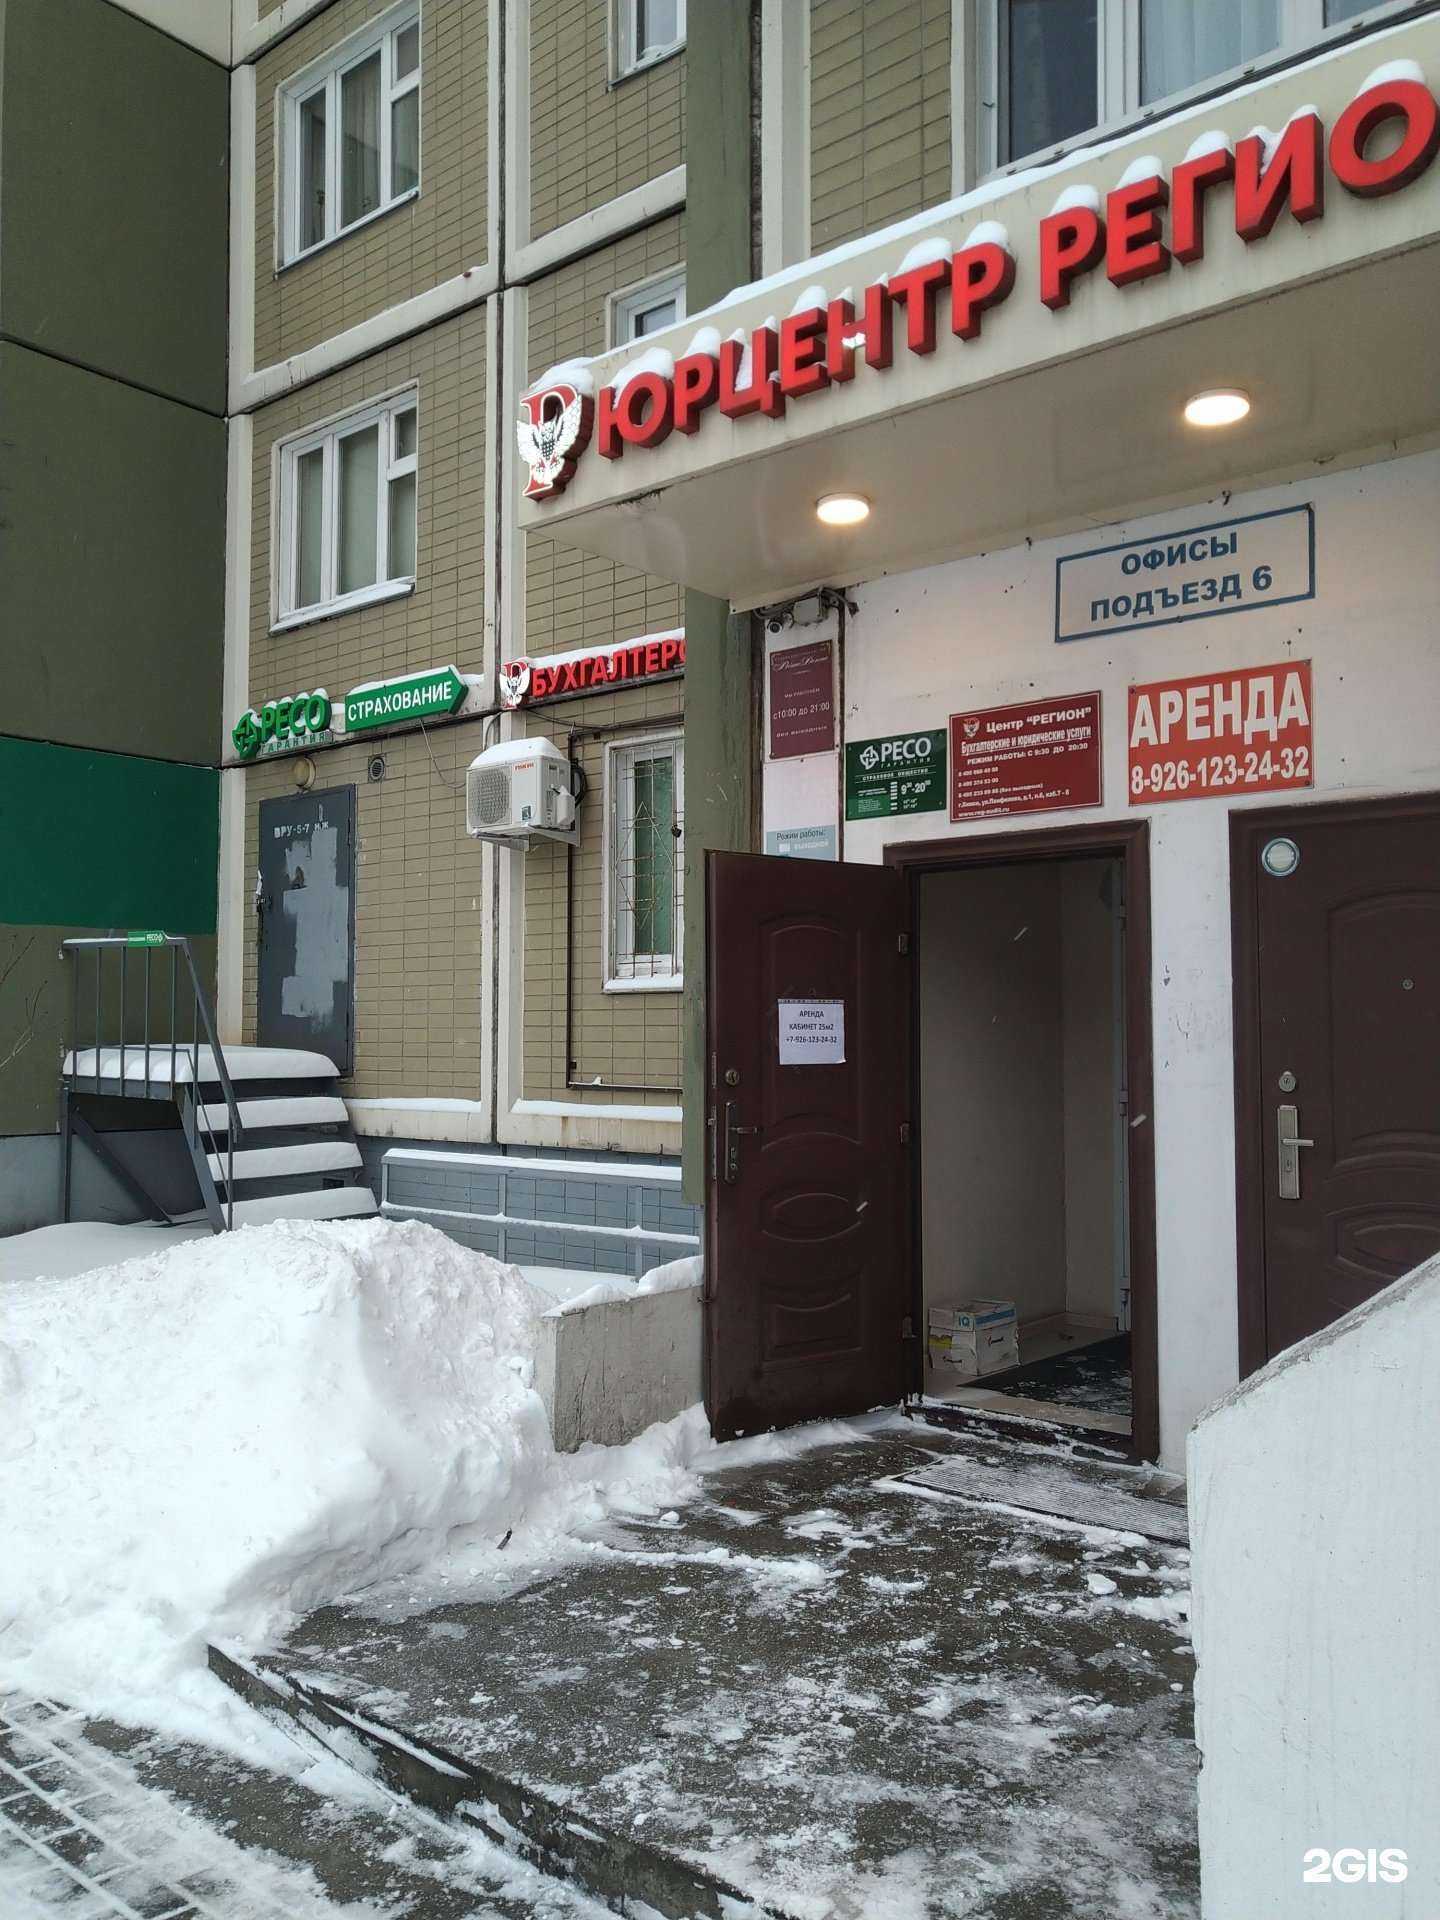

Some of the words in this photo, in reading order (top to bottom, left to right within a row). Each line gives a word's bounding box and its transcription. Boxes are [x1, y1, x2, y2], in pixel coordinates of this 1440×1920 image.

[599, 242, 1015, 460] ЮРЦЕНТР
[1040, 79, 1440, 310] РЕГИО
[1121, 532, 1237, 575] ОФИСЫ
[1091, 573, 1242, 621] ПОДЪЕЗД
[1252, 565, 1273, 591] 6
[262, 693, 332, 743] РЕСО
[348, 681, 453, 722] СТРАХОВАНИЕ
[1130, 671, 1310, 748] АРЕНДА
[961, 738, 1011, 756] Бухгалтерские
[1012, 738, 1017, 746] и
[1017, 730, 1066, 747] юридические
[1067, 725, 1092, 741] услуги
[986, 719, 1023, 734] Центр
[881, 737, 931, 763] РЕСО
[967, 755, 993, 766] РЕЖИМ
[1053, 745, 1064, 754] ДО
[1131, 746, 1309, 795] 8-926-123-24-32
[799, 1010, 824, 1018] АРЕНДА
